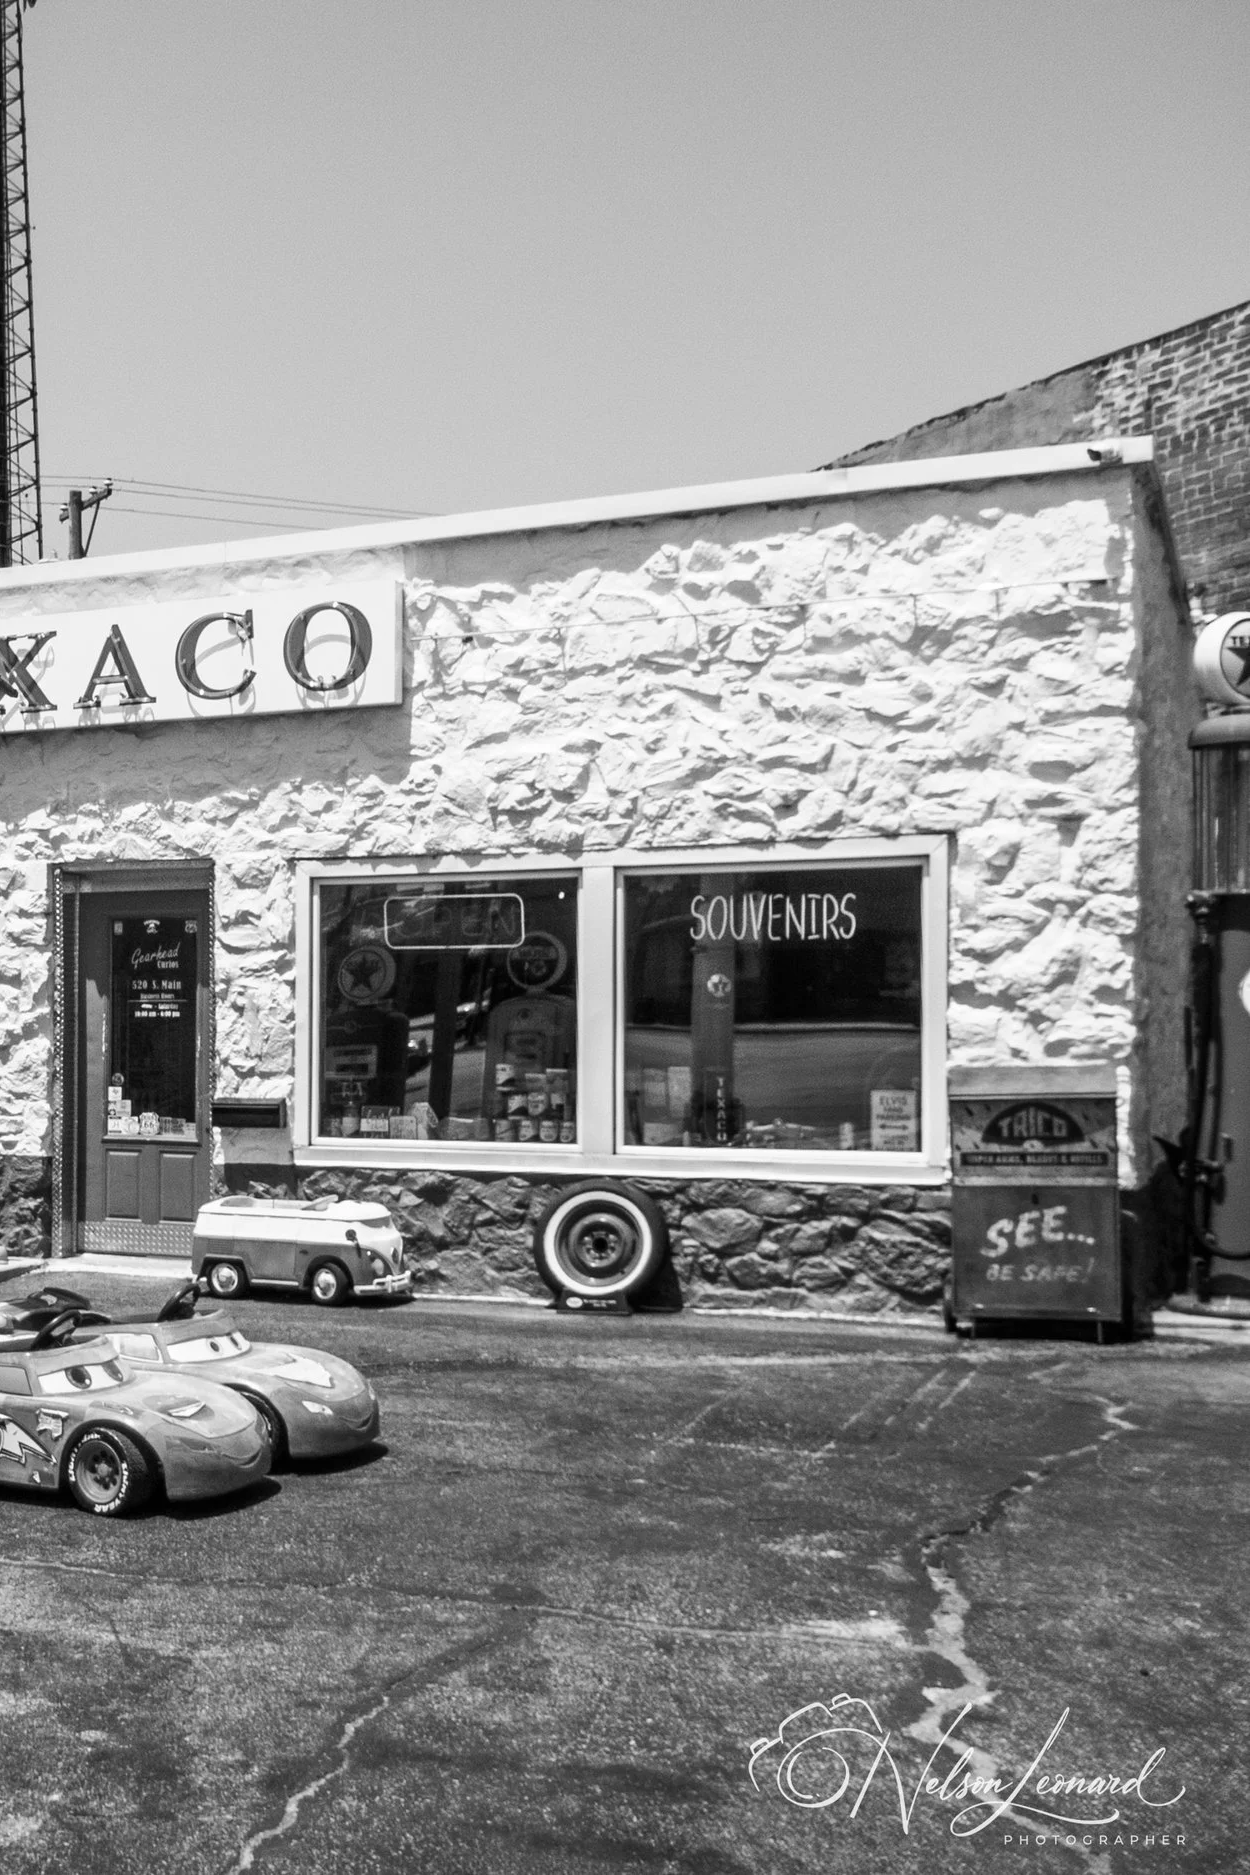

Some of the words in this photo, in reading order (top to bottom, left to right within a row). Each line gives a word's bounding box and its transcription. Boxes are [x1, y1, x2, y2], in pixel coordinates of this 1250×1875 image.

[1231, 636, 1250, 647] TE
[690, 892, 857, 941] SOUVENIRS
[131, 941, 181, 970] Gearhead
[157, 960, 179, 969] Curios
[132, 979, 148, 990] 520
[161, 979, 181, 990] Main
[998, 1106, 1068, 1138] TRICO
[980, 1205, 1096, 1258] SEE...
[986, 1263, 1015, 1282] BE
